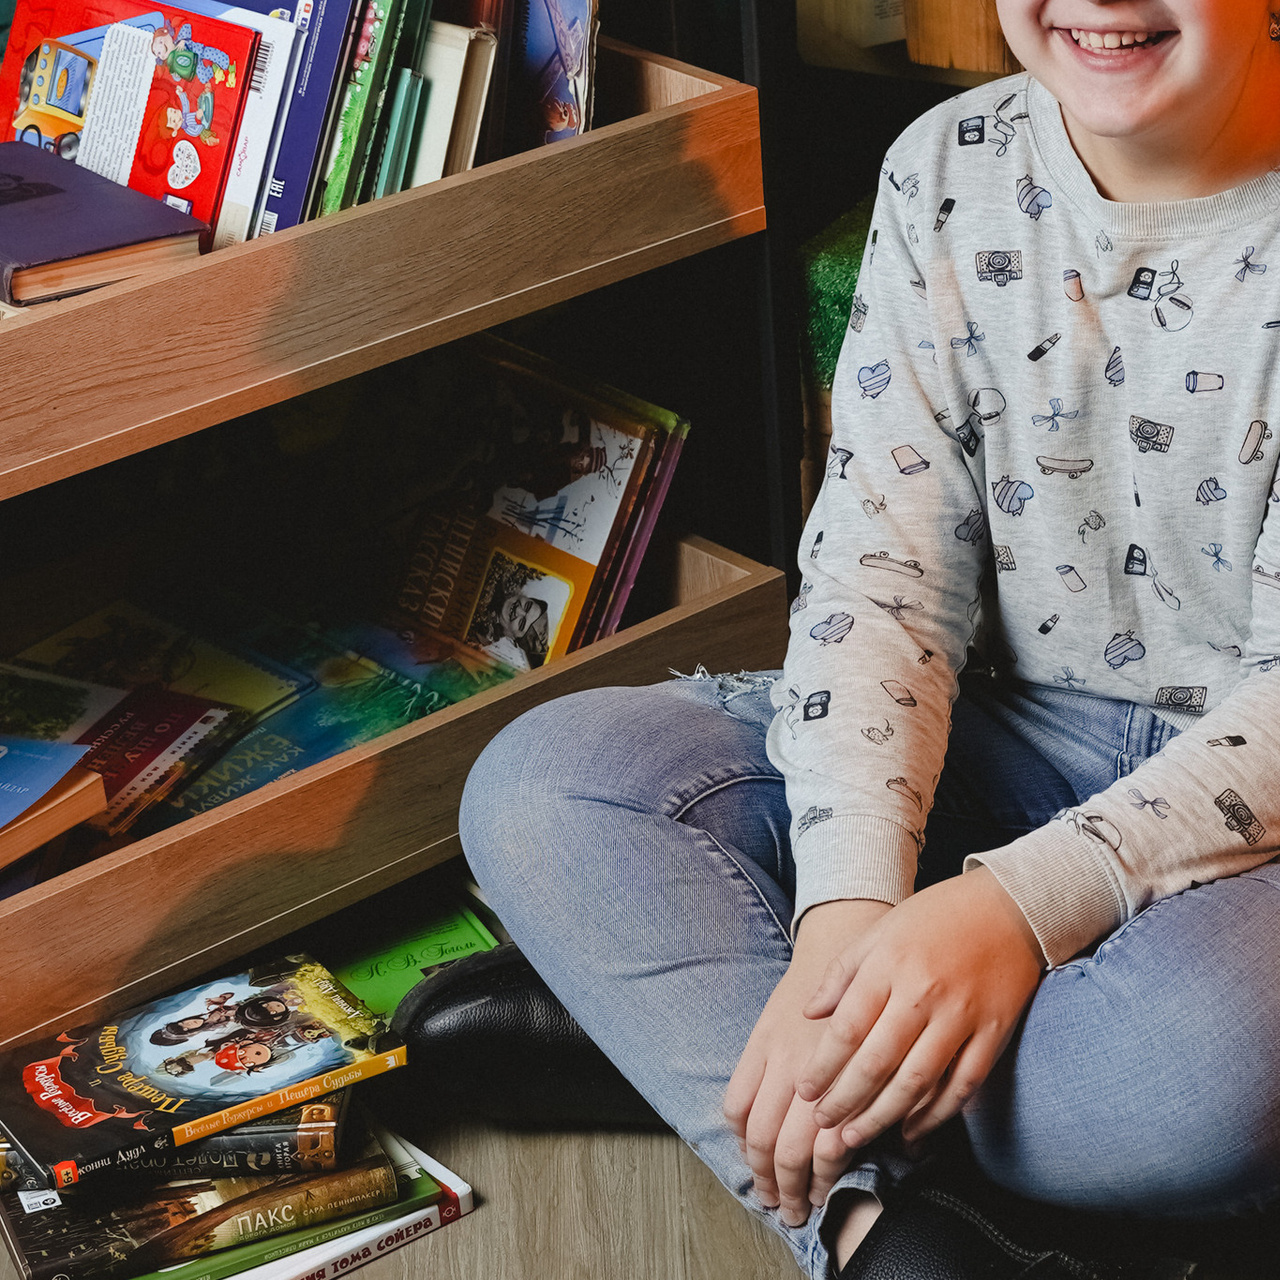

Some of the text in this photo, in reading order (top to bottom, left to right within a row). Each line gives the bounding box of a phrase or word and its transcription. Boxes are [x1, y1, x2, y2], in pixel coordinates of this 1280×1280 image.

[262, 745, 305, 772] КАК
[189, 774, 257, 815] ЖИВУТ
[421, 941, 477, 960] Гоголь
[96, 1025, 128, 1075] Судьбы
[117, 1071, 189, 1113] Пещера
[278, 1084, 321, 1105] Пещера
[322, 1069, 363, 1090] Судьбы
[61, 1169, 74, 1185] 6+
[77, 1155, 111, 1177] жонни
[116, 1143, 147, 1164] Дудл
[237, 1204, 295, 1236] ПАКС
[303, 1189, 381, 1217] САРА ПЕННИПАКЕР
[330, 1245, 372, 1274] ТОМА
[376, 1216, 434, 1252] СОЙЕРА
